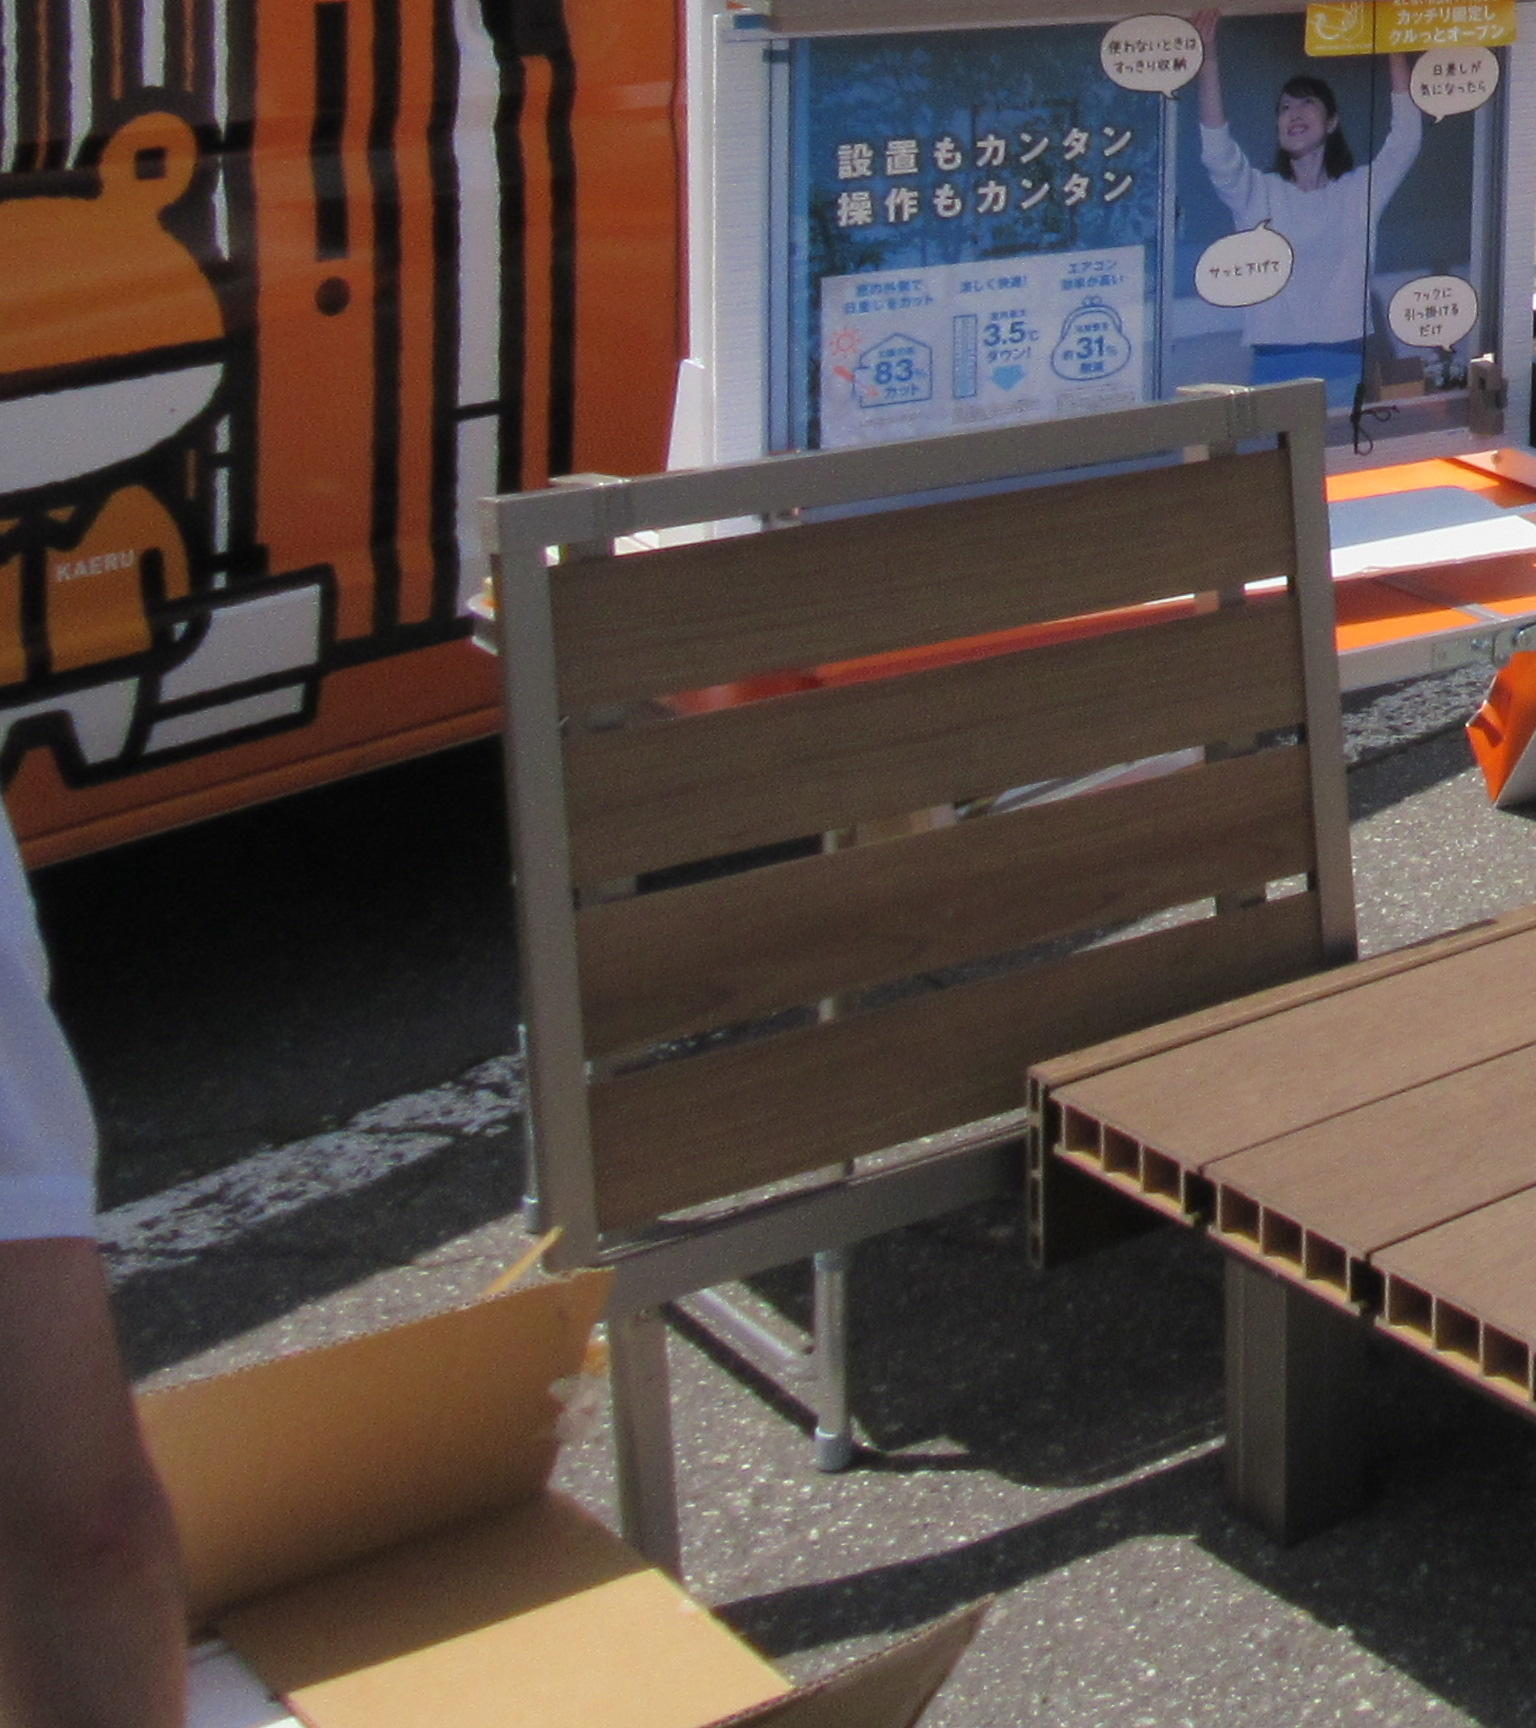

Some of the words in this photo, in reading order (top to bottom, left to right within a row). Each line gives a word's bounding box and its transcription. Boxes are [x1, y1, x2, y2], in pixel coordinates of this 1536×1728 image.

[837, 126, 1132, 179] 設置もカンタン
[837, 171, 1132, 228] 操作もカンタン
[1067, 259, 1118, 274] エアコン
[1420, 324, 1442, 337] だけ
[56, 549, 135, 582] KAERU
